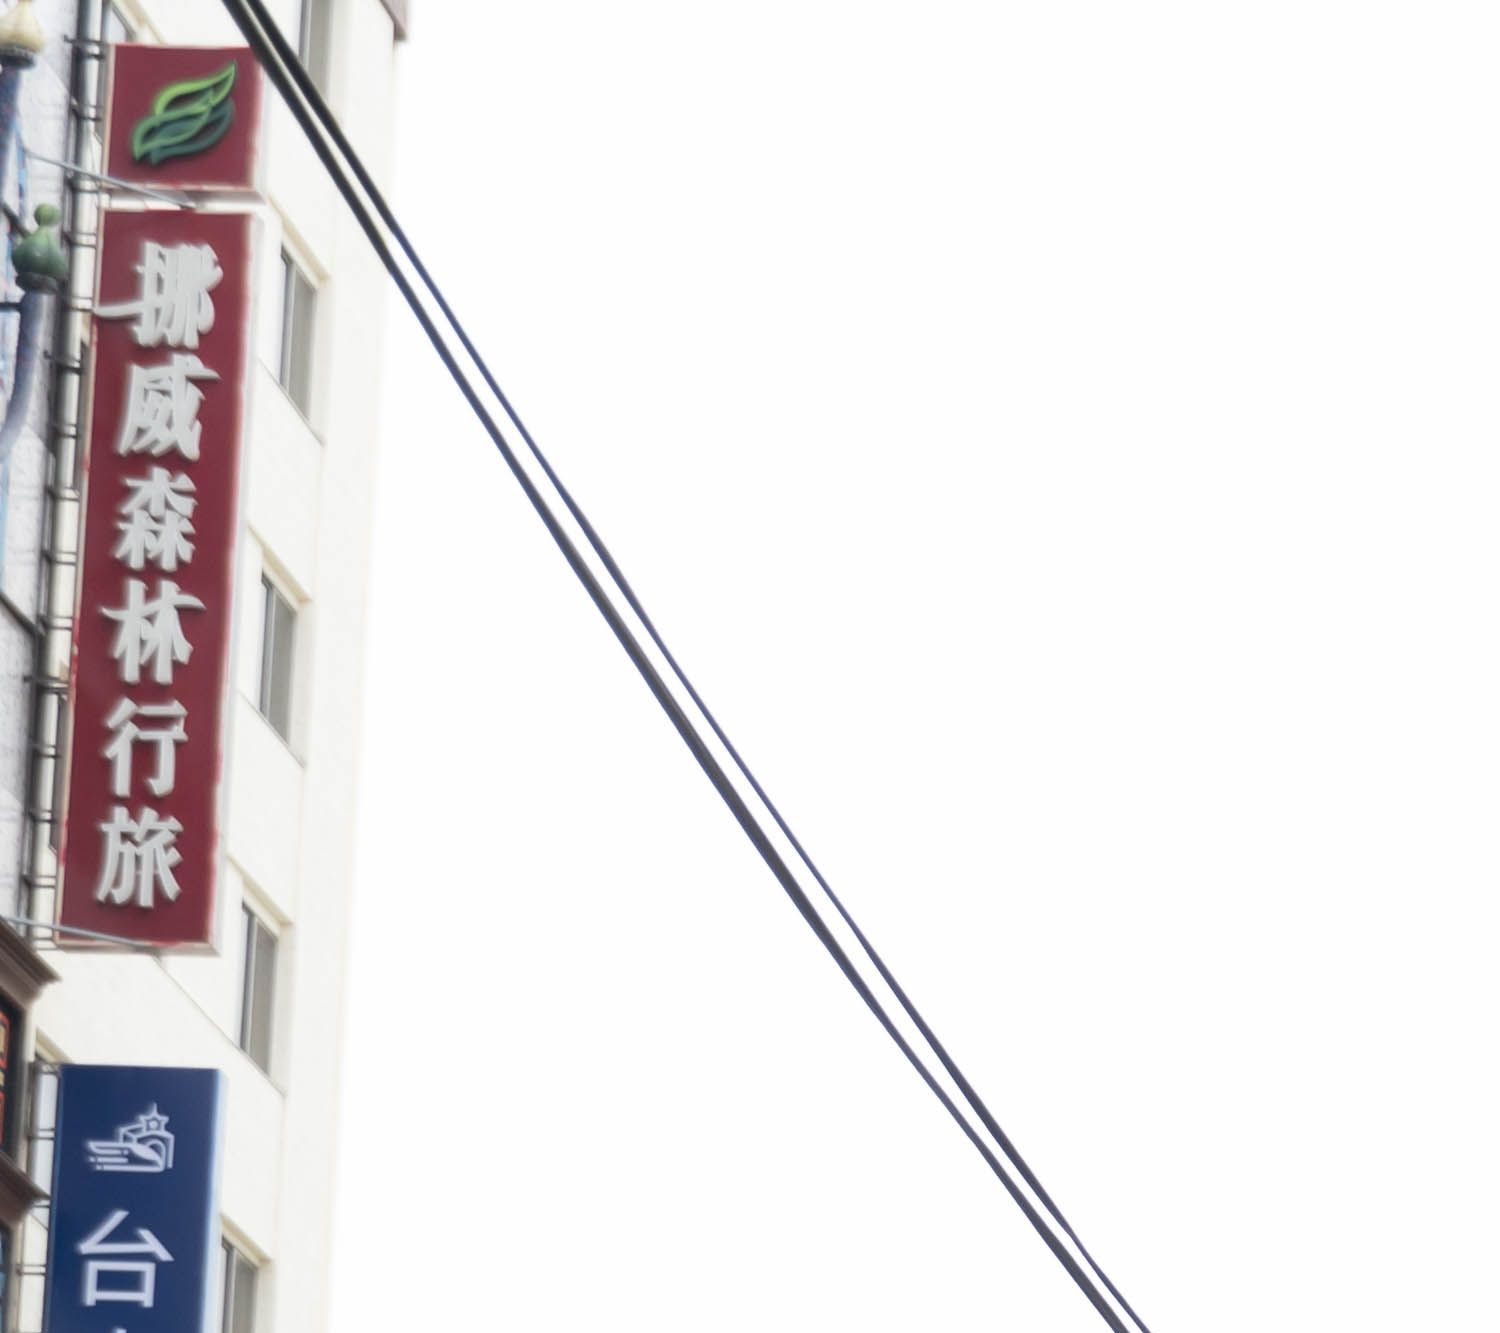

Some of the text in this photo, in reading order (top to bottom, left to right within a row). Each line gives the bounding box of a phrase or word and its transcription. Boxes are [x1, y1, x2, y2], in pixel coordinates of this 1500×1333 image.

[94, 241, 223, 909] 挪威森林行旅
